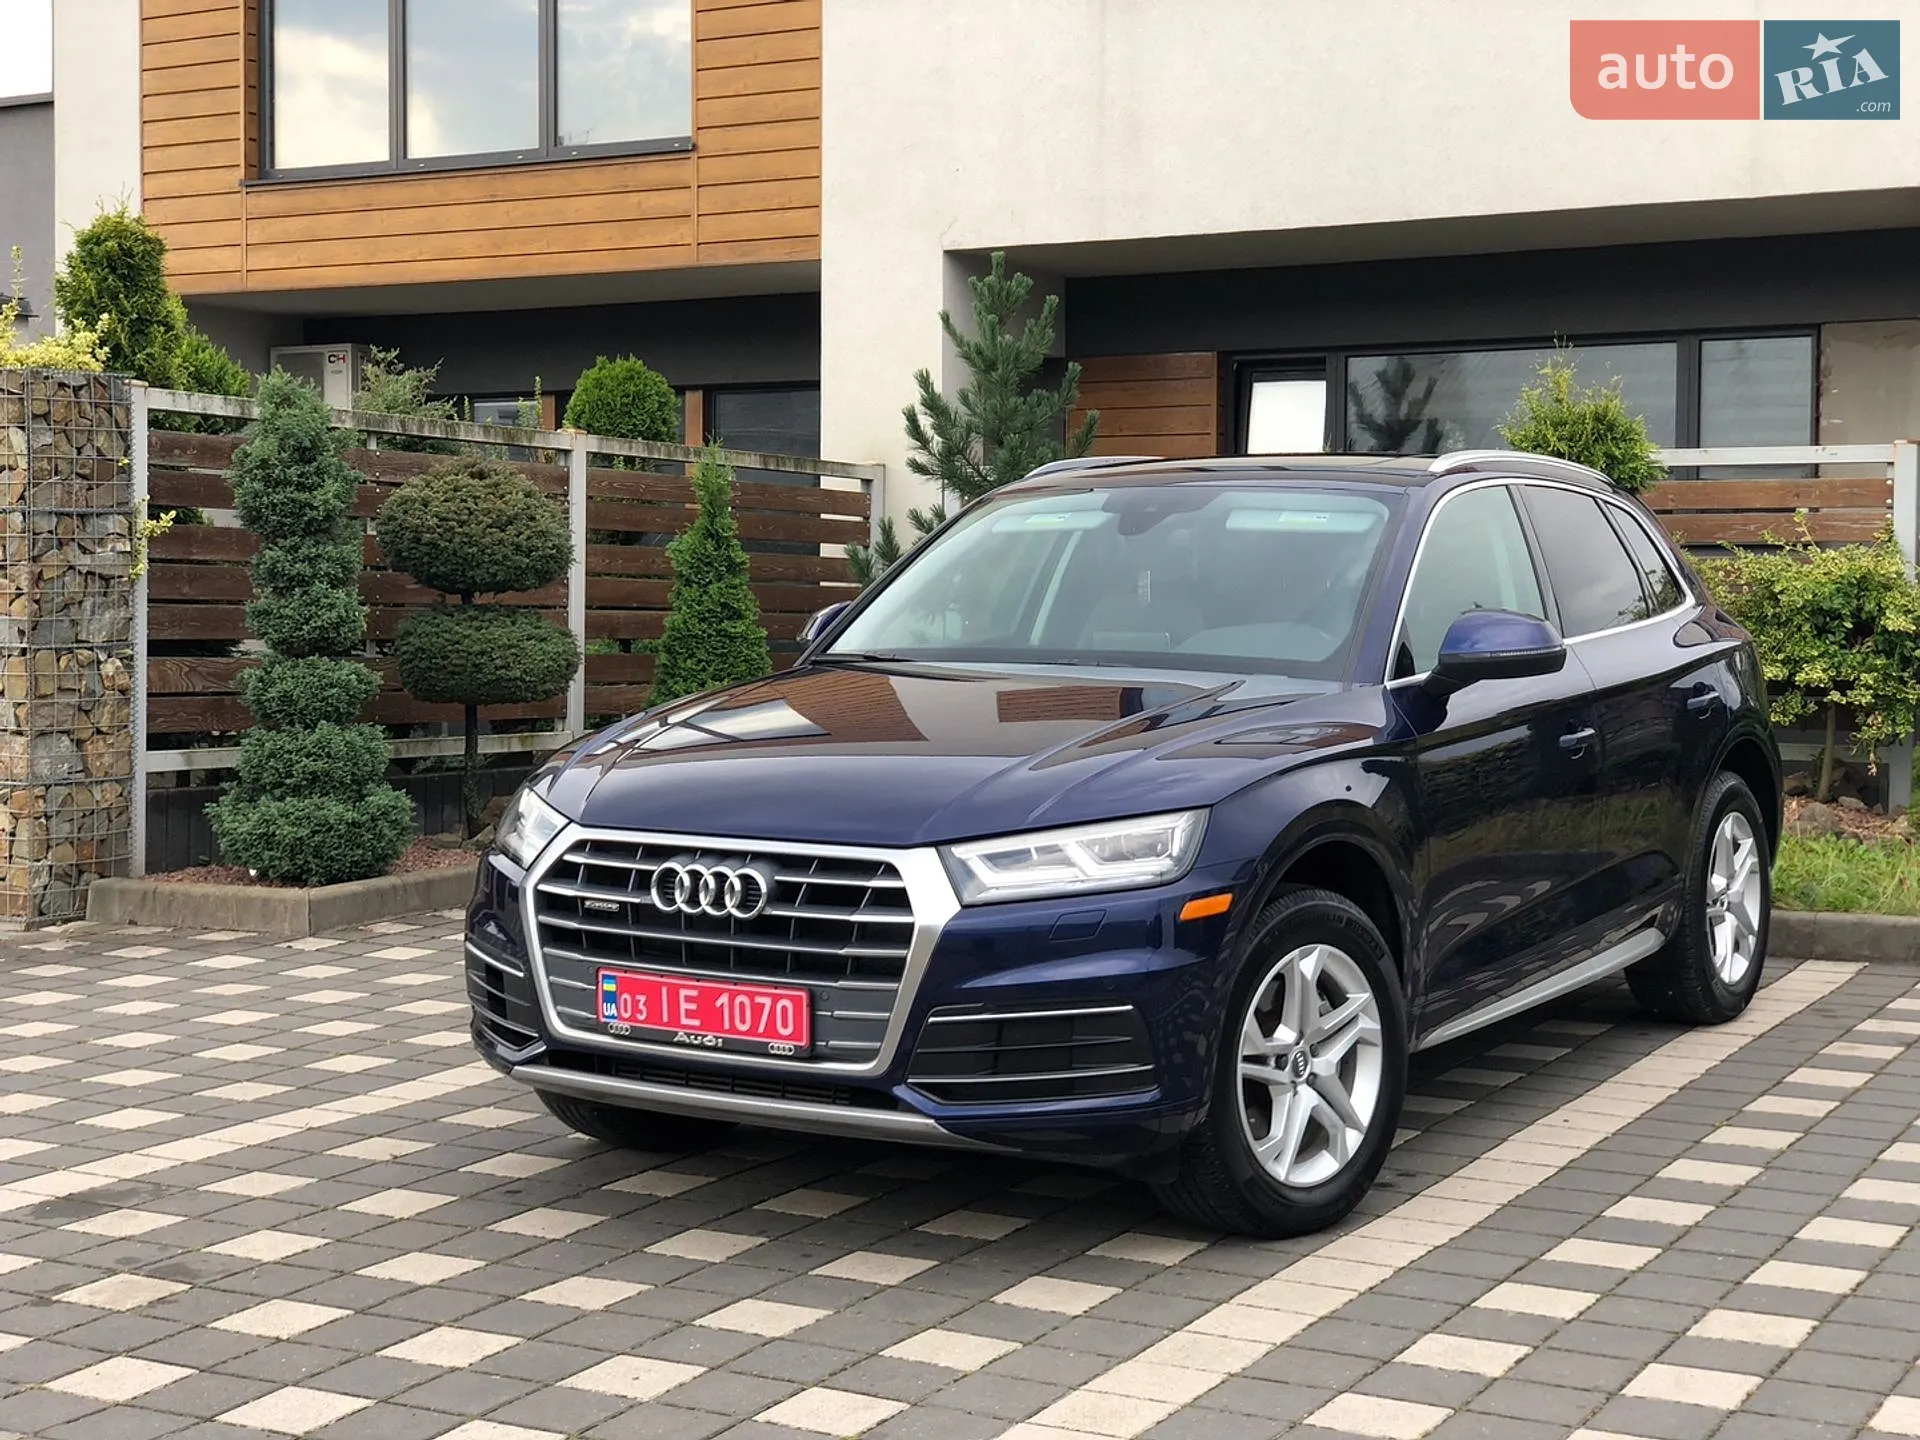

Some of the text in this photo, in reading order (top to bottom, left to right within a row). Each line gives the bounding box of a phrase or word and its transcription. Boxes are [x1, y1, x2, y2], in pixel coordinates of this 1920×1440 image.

[327, 353, 347, 364] CH
[603, 1002, 618, 1017] UA
[620, 993, 648, 1021] 03
[714, 992, 795, 1037] 1070
[673, 1031, 724, 1048] Audi
